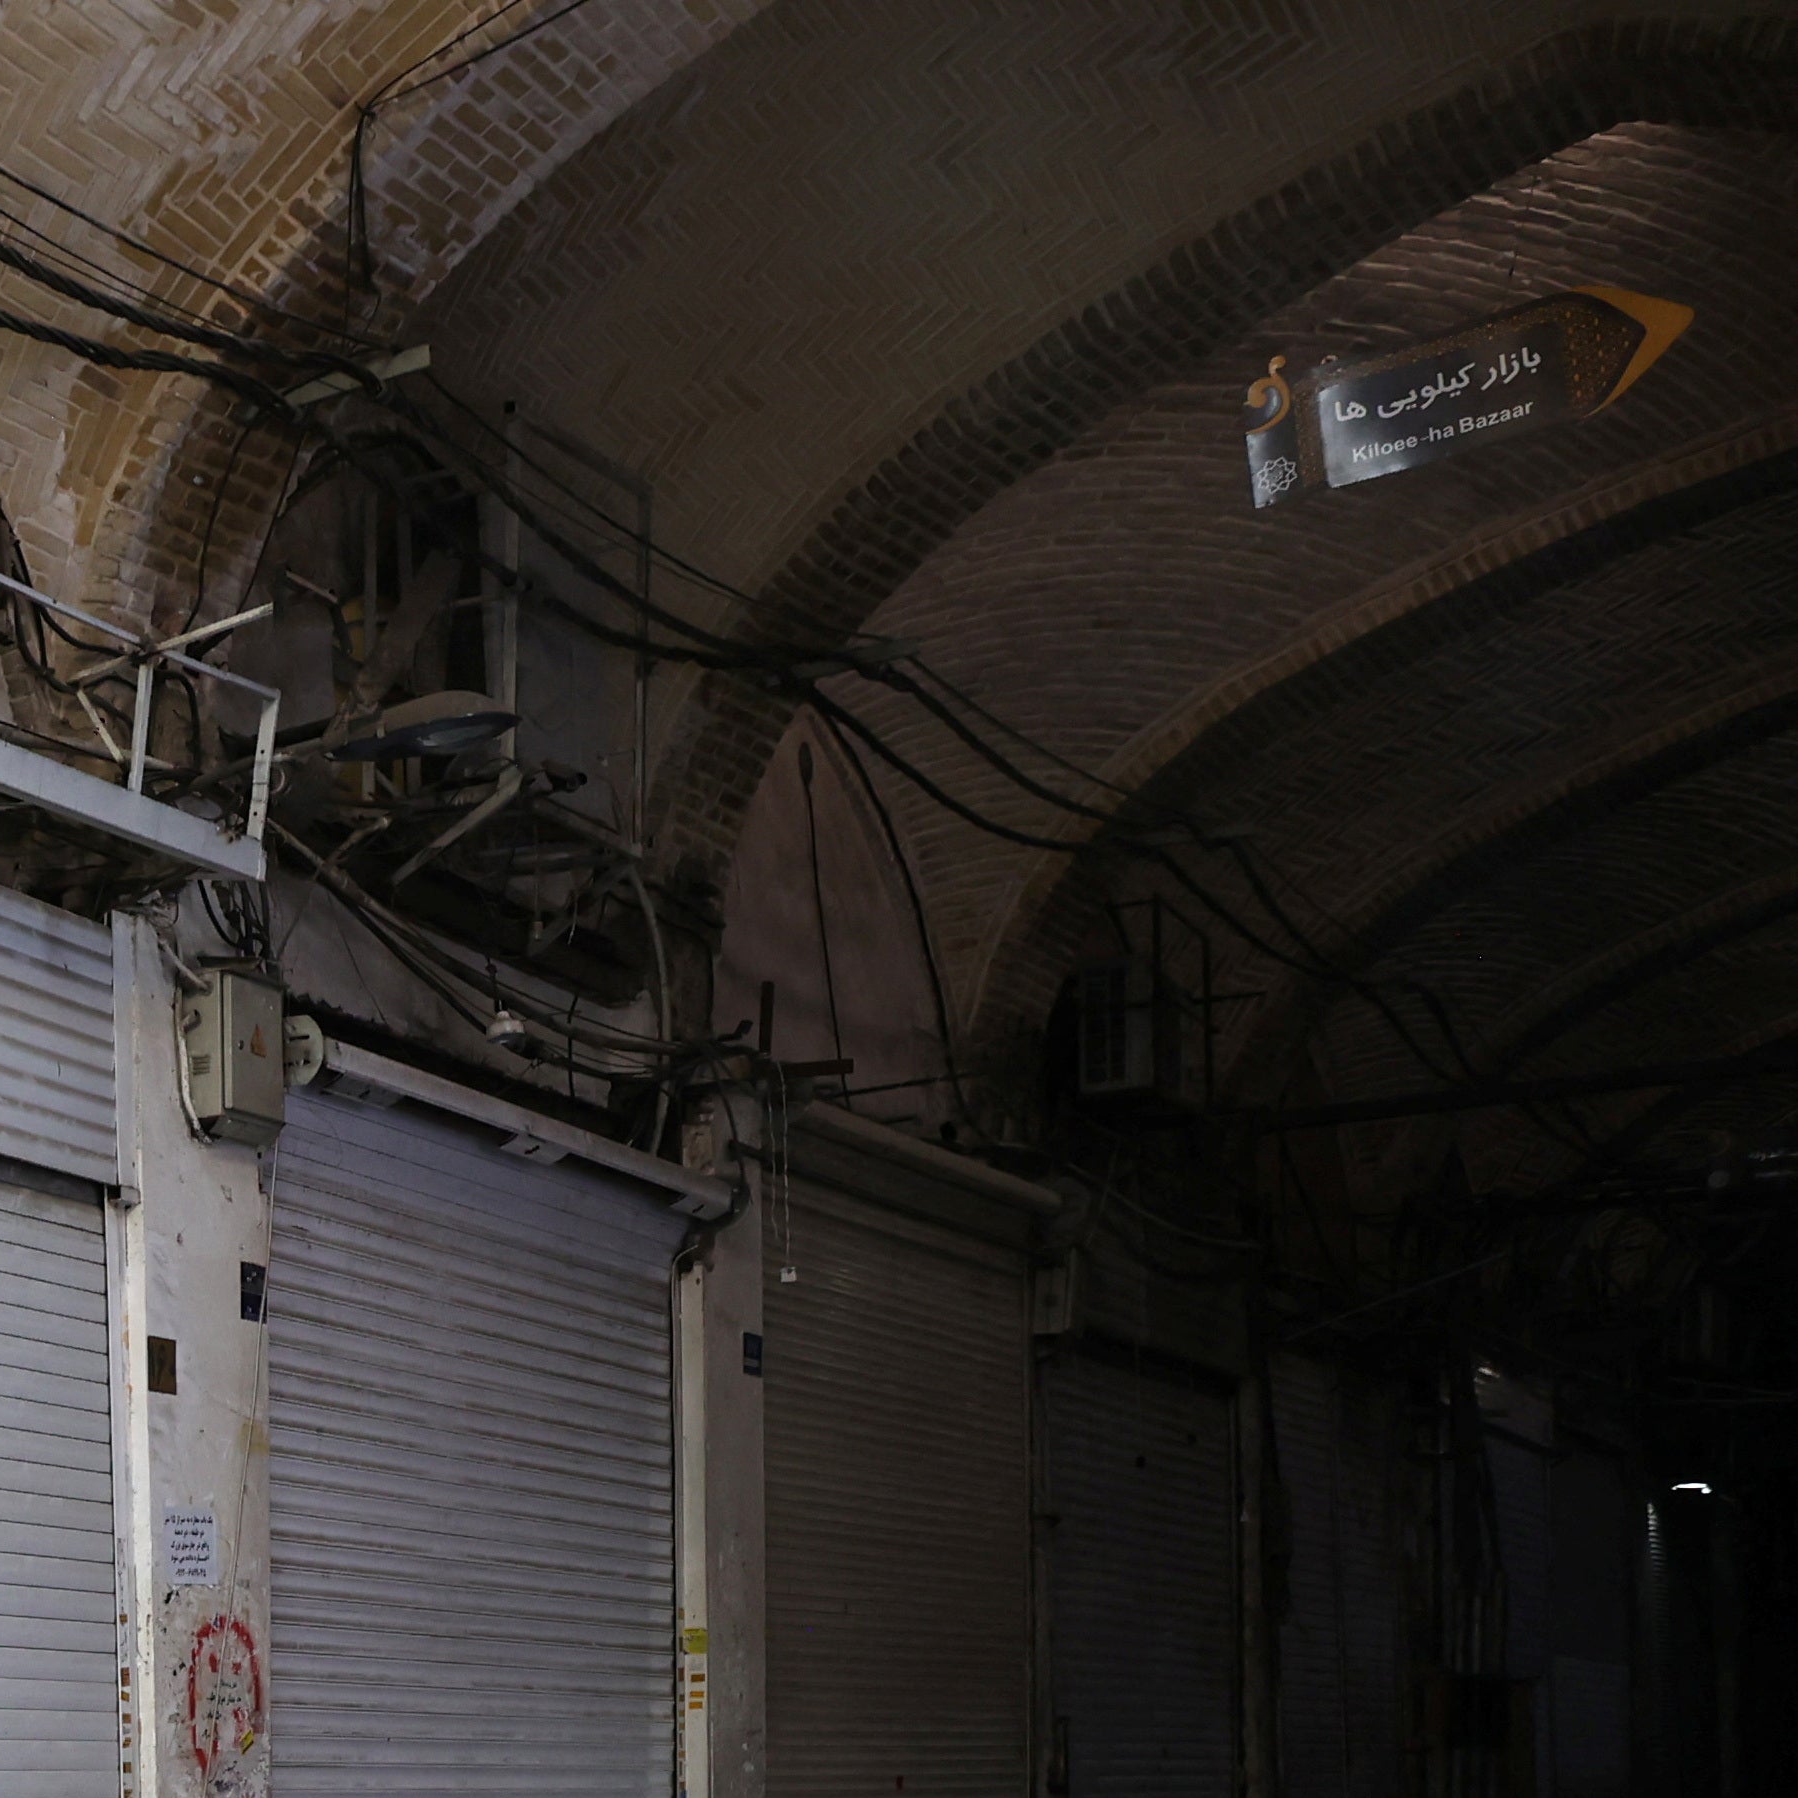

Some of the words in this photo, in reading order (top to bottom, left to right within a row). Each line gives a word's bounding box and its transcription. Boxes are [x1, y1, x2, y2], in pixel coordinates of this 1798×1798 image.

[1377, 362, 1476, 420] کیلویی
[1481, 347, 1542, 391] بازار
[1334, 399, 1367, 423] ها
[1352, 424, 1455, 463] Kiloee-ha
[1459, 401, 1534, 434] Bazaar
